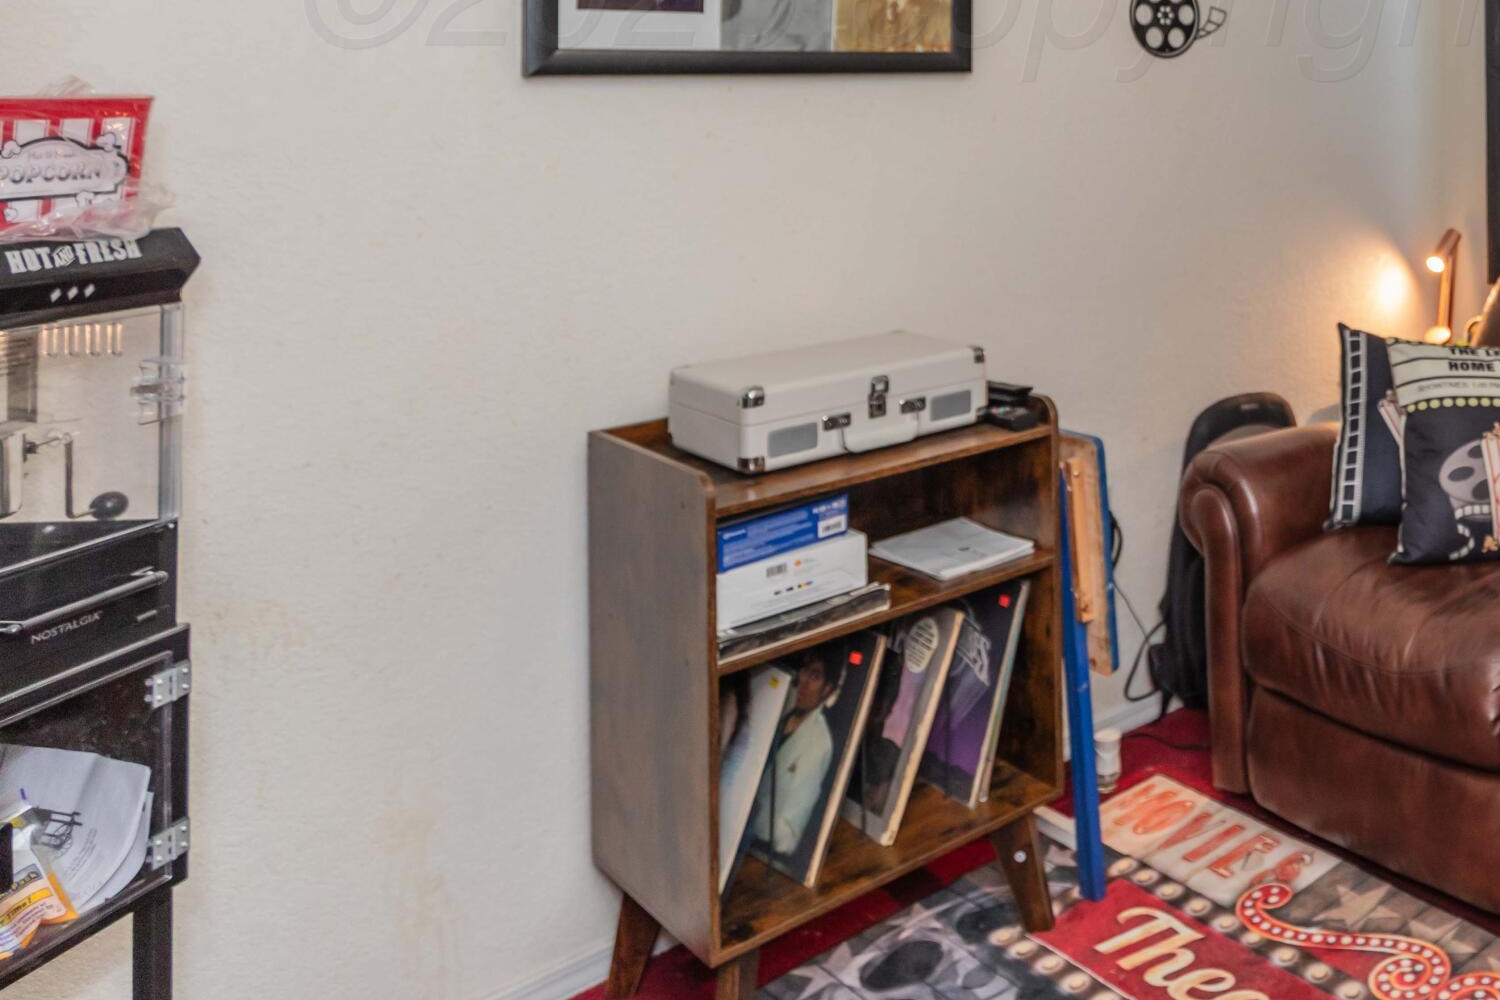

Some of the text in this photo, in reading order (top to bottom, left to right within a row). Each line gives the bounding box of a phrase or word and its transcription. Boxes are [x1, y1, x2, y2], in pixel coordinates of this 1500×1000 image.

[5, 247, 54, 274] HOT
[73, 239, 143, 265] FRESH
[1448, 361, 1495, 373] HOME
[31, 612, 102, 645] NOSTALGIA
[1114, 782, 1314, 887] MOVIES
